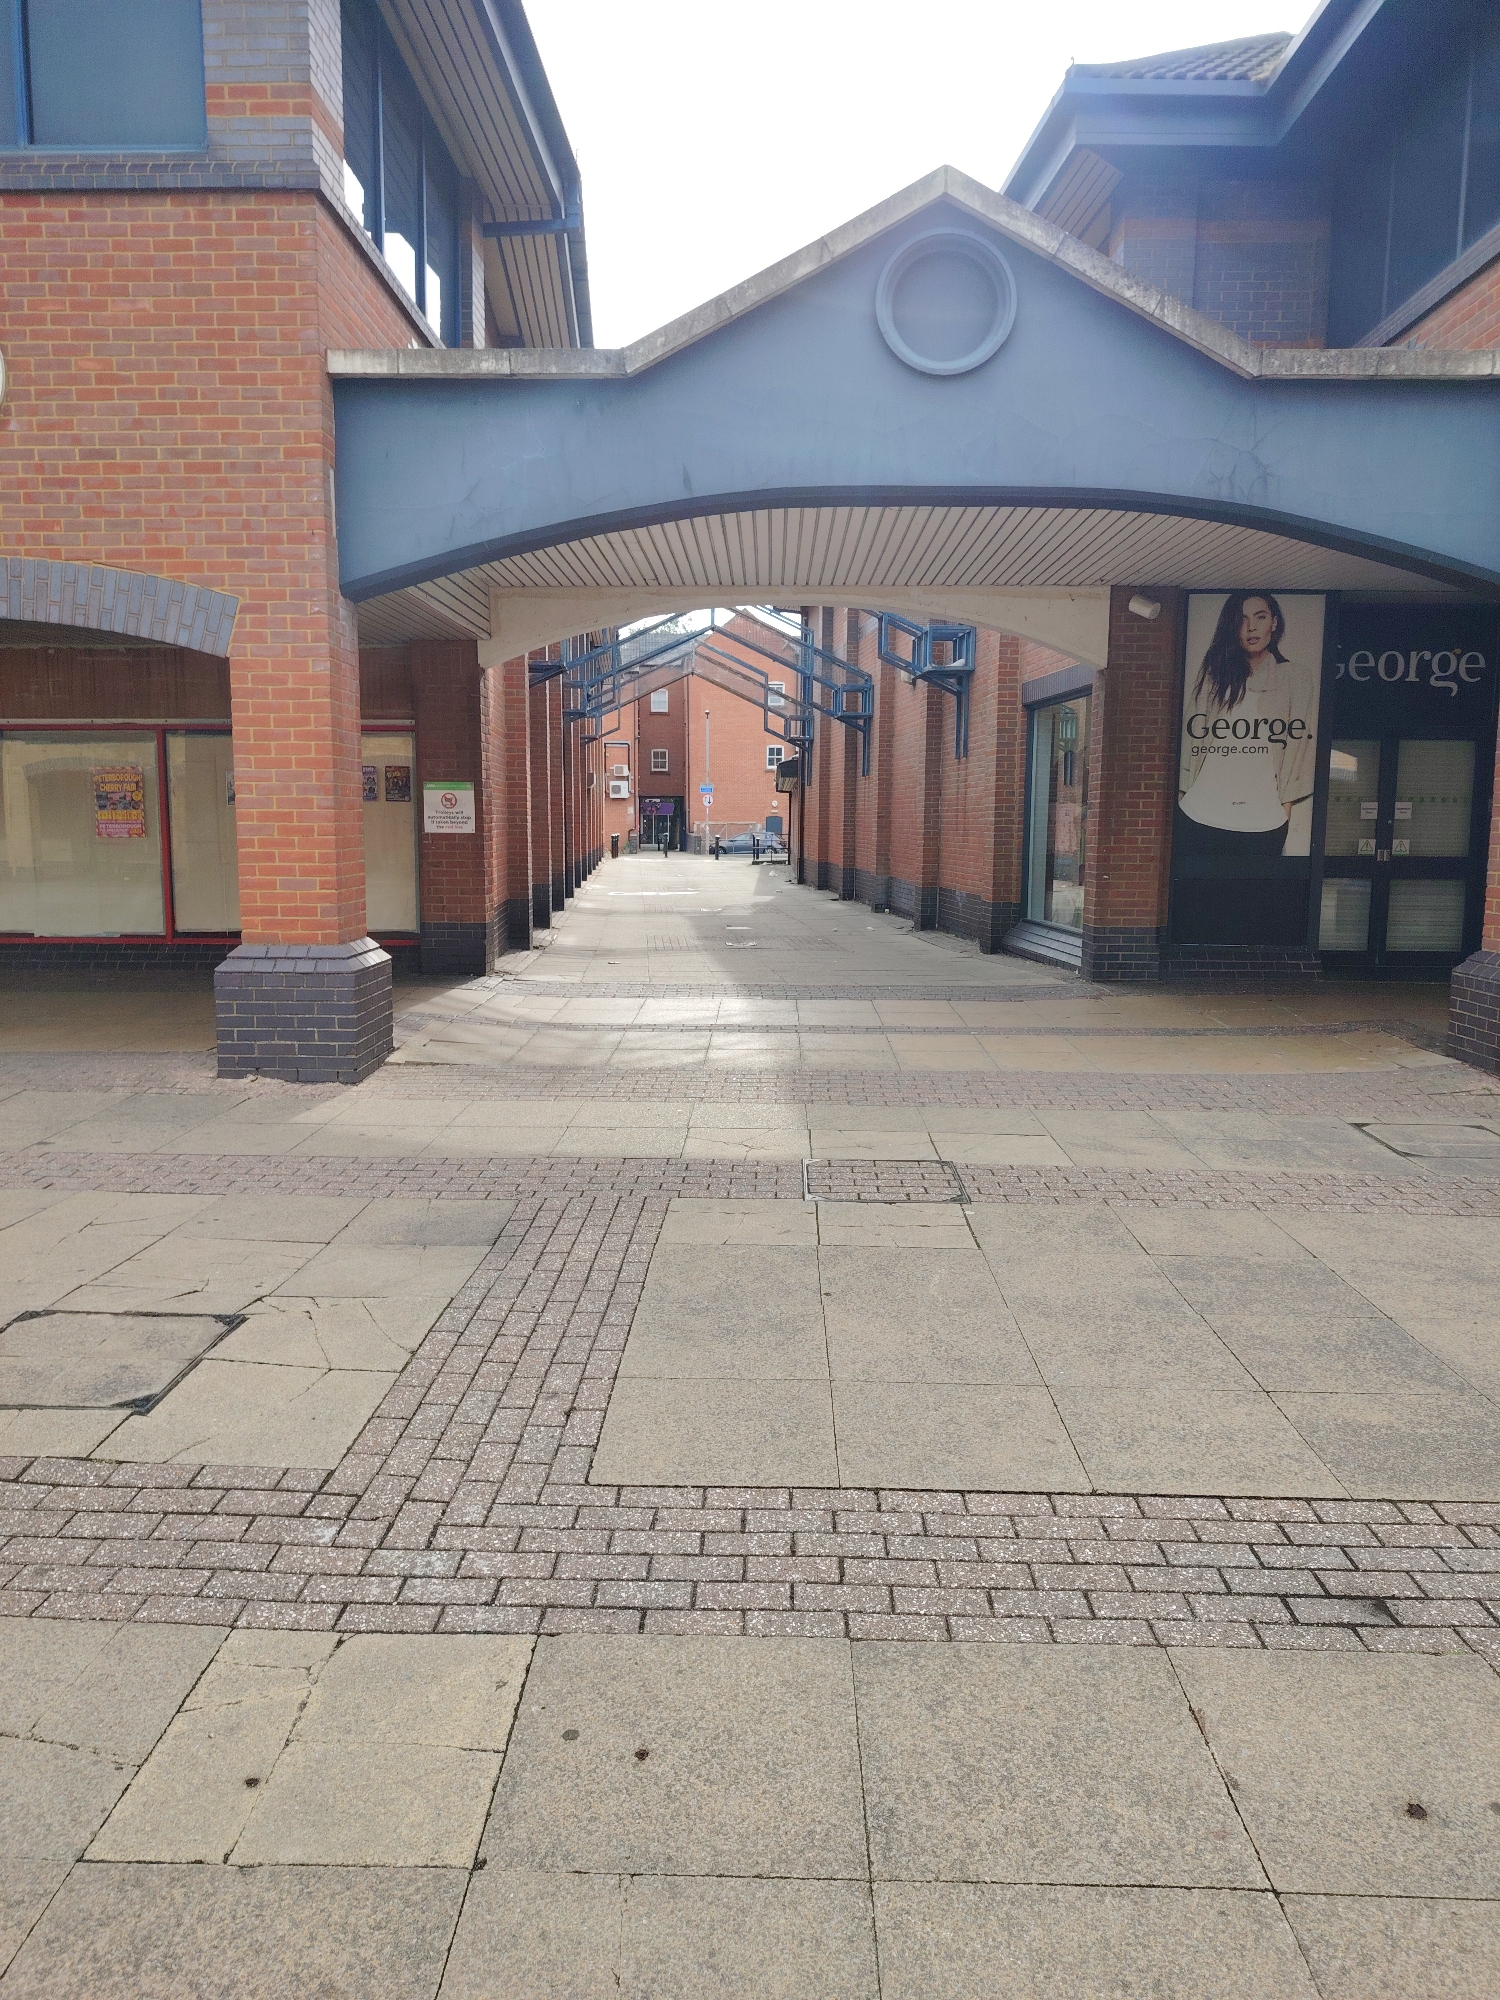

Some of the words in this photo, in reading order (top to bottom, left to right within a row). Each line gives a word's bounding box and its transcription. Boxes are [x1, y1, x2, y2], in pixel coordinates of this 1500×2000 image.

[1186, 713, 1313, 750] George.
[1191, 745, 1269, 757] george.com
[94, 773, 141, 782] PETERBOROUGH
[100, 783, 122, 792] CHERRY
[124, 784, 137, 792] FAIR
